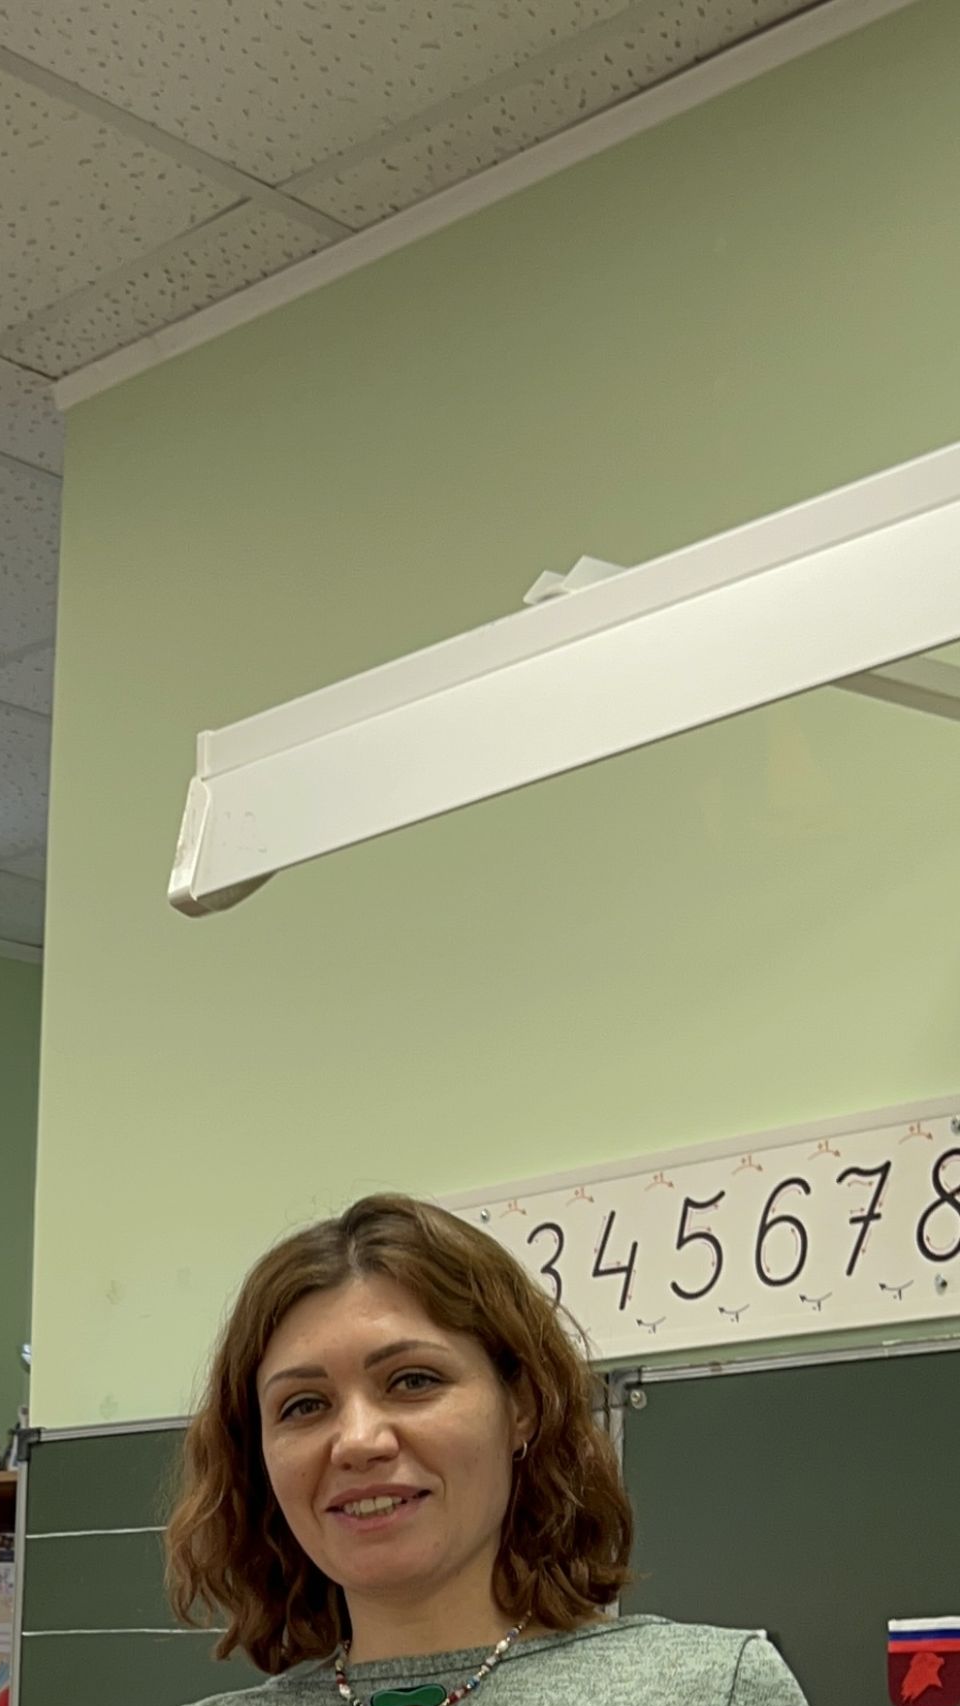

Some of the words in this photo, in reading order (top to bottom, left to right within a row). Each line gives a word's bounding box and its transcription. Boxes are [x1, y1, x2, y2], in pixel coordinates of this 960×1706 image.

[527, 1222, 564, 1308] 3
[592, 1210, 638, 1310] 4
[670, 1190, 726, 1300] 5
[755, 1177, 812, 1287] 6
[836, 1160, 891, 1277] 7
[916, 1148, 960, 1262] 8
